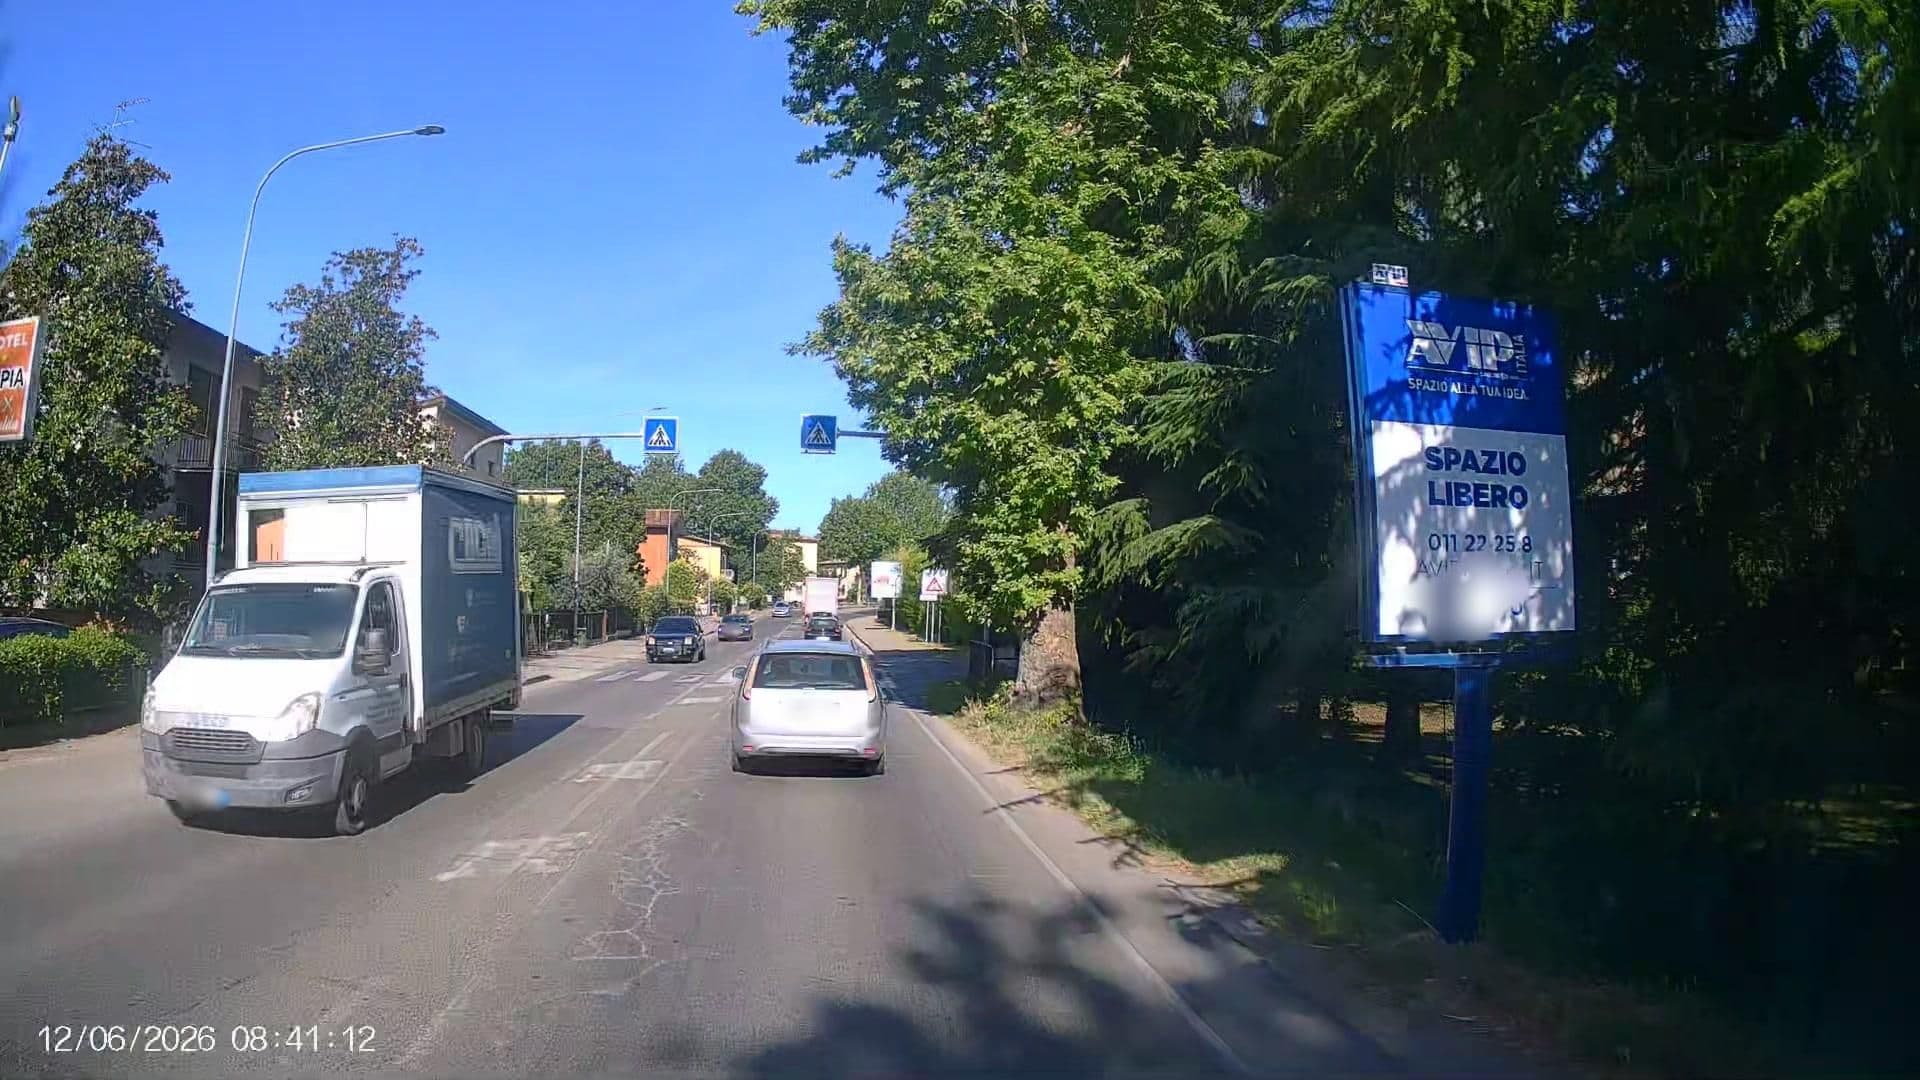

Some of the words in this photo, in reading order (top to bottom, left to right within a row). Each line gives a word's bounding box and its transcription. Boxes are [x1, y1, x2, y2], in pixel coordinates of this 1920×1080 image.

[1406, 319, 1515, 371] AVIP
[1408, 377, 1448, 393] SPAZIO
[1450, 382, 1478, 395] ALLA
[1480, 384, 1501, 397] TUA
[1425, 447, 1527, 476] SPAZIO
[1428, 480, 1528, 510] LIBERO
[1428, 533, 1458, 552] 011
[1464, 534, 1487, 552] 22
